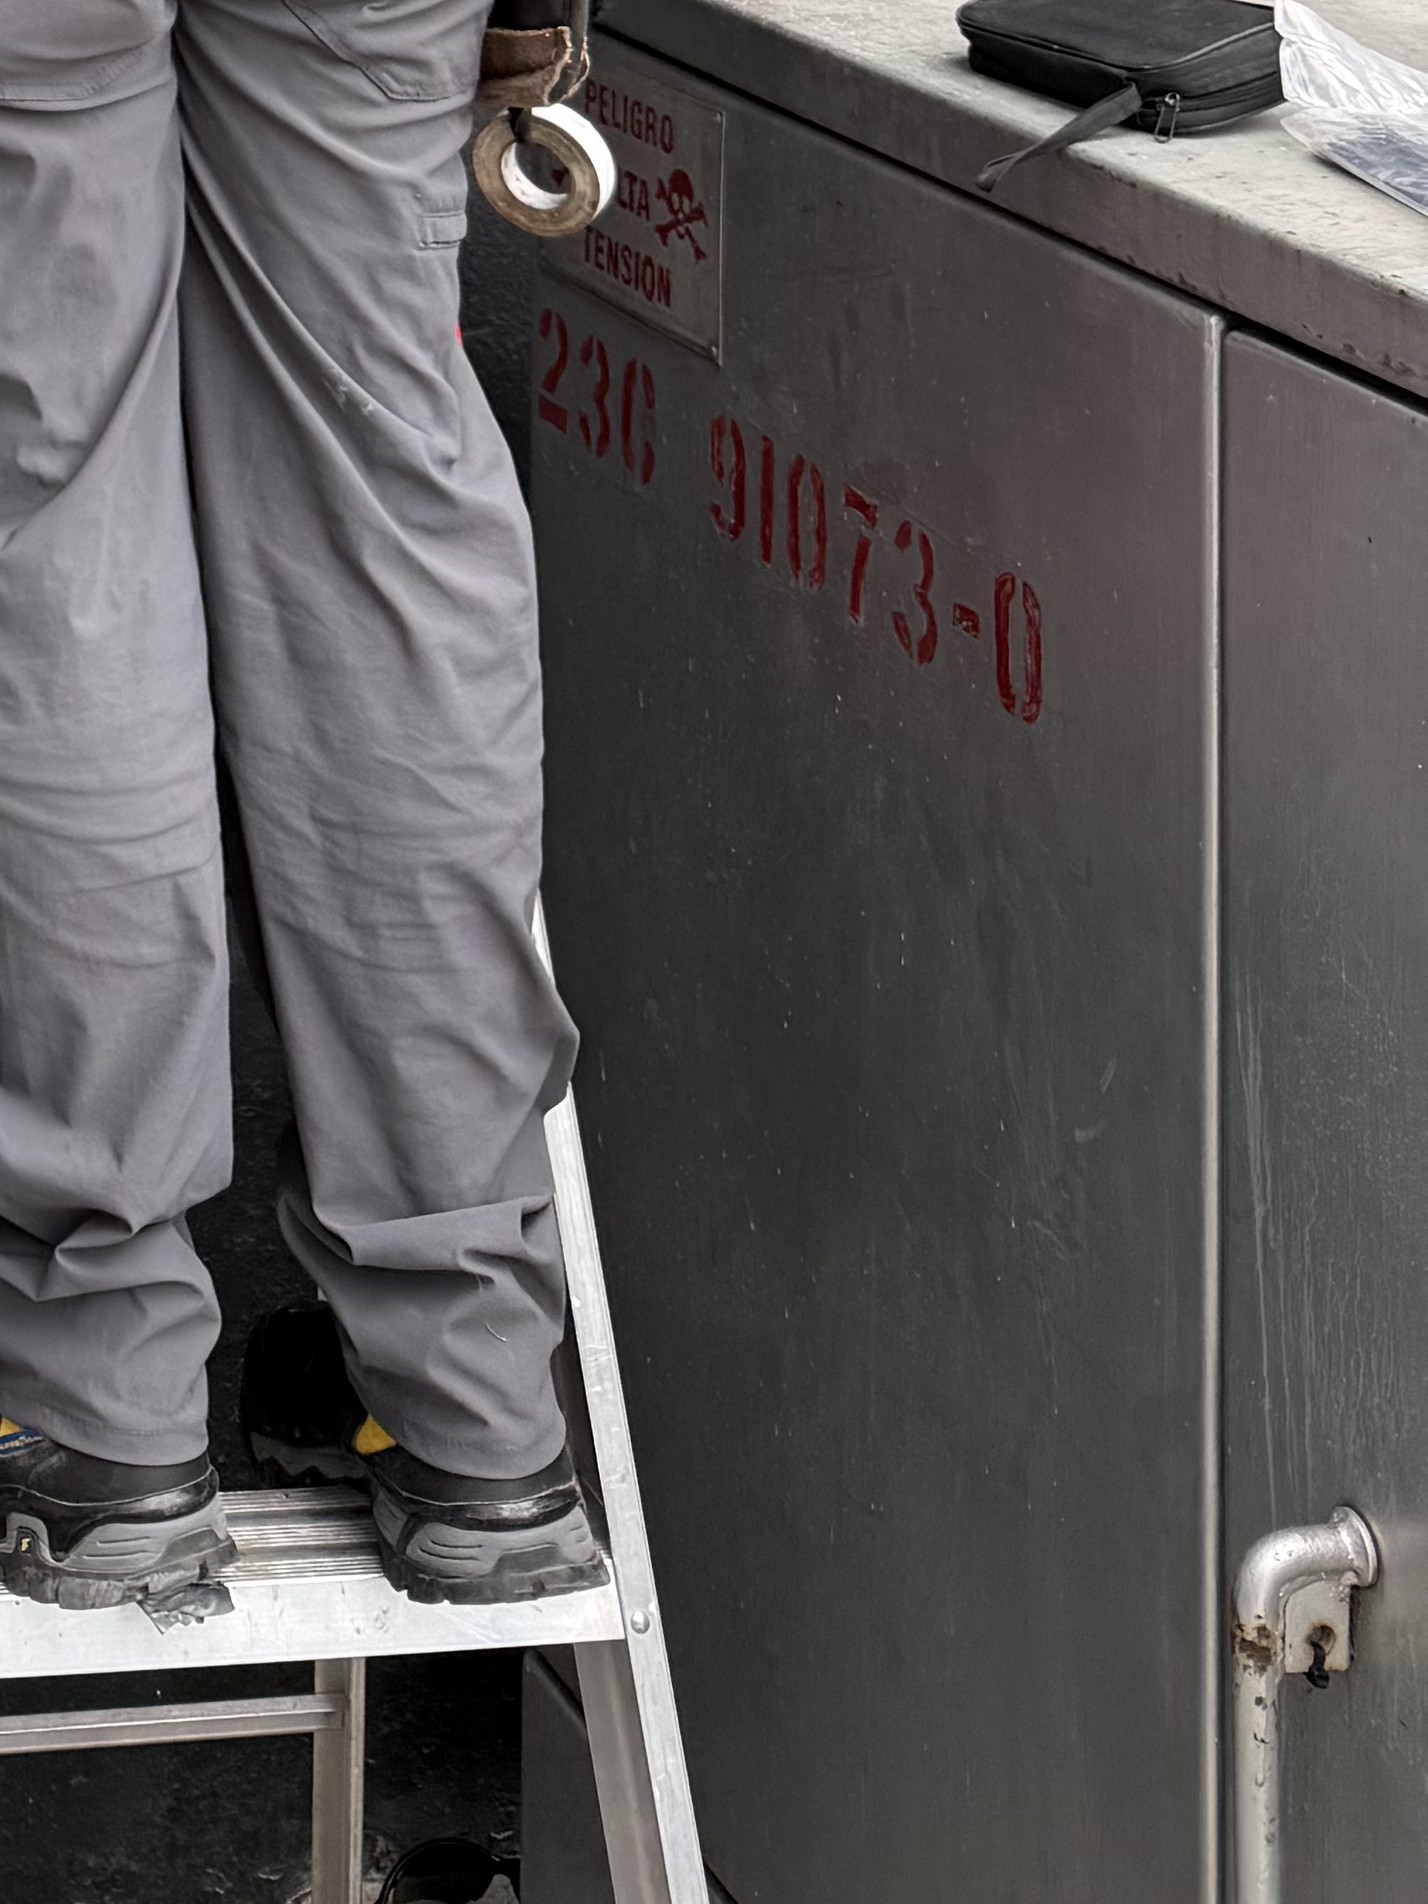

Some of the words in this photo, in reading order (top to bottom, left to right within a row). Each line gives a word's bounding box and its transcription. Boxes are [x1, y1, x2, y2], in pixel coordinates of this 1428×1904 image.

[584, 78, 675, 154] PELIGRO
[582, 224, 672, 308] TENSION
[708, 414, 1043, 726] 91073-0
